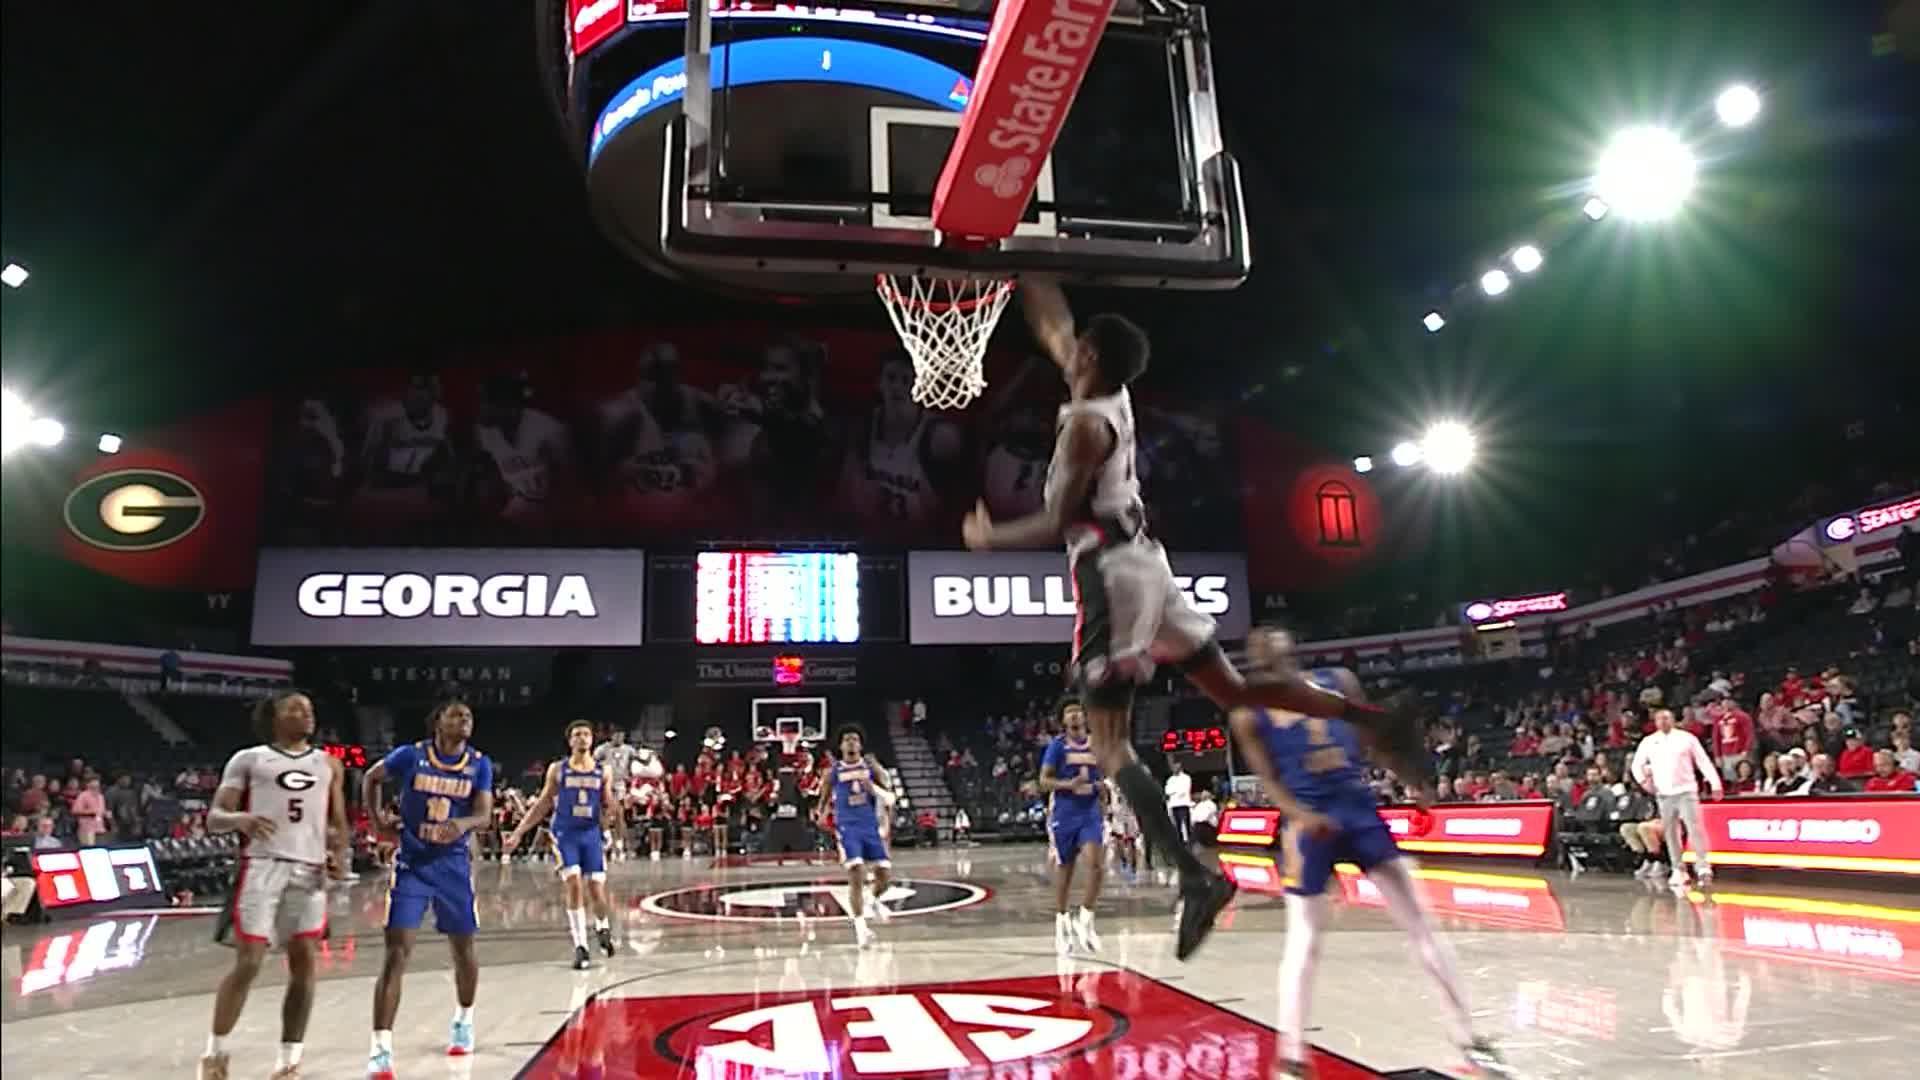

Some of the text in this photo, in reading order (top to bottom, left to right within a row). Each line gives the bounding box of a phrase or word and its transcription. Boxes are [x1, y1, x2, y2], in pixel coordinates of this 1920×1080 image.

[297, 573, 598, 618] GEORGIA
[932, 575, 1230, 616] BULLS
[275, 769, 320, 792] G
[287, 798, 304, 824] 5
[708, 993, 1094, 1073] SEC
